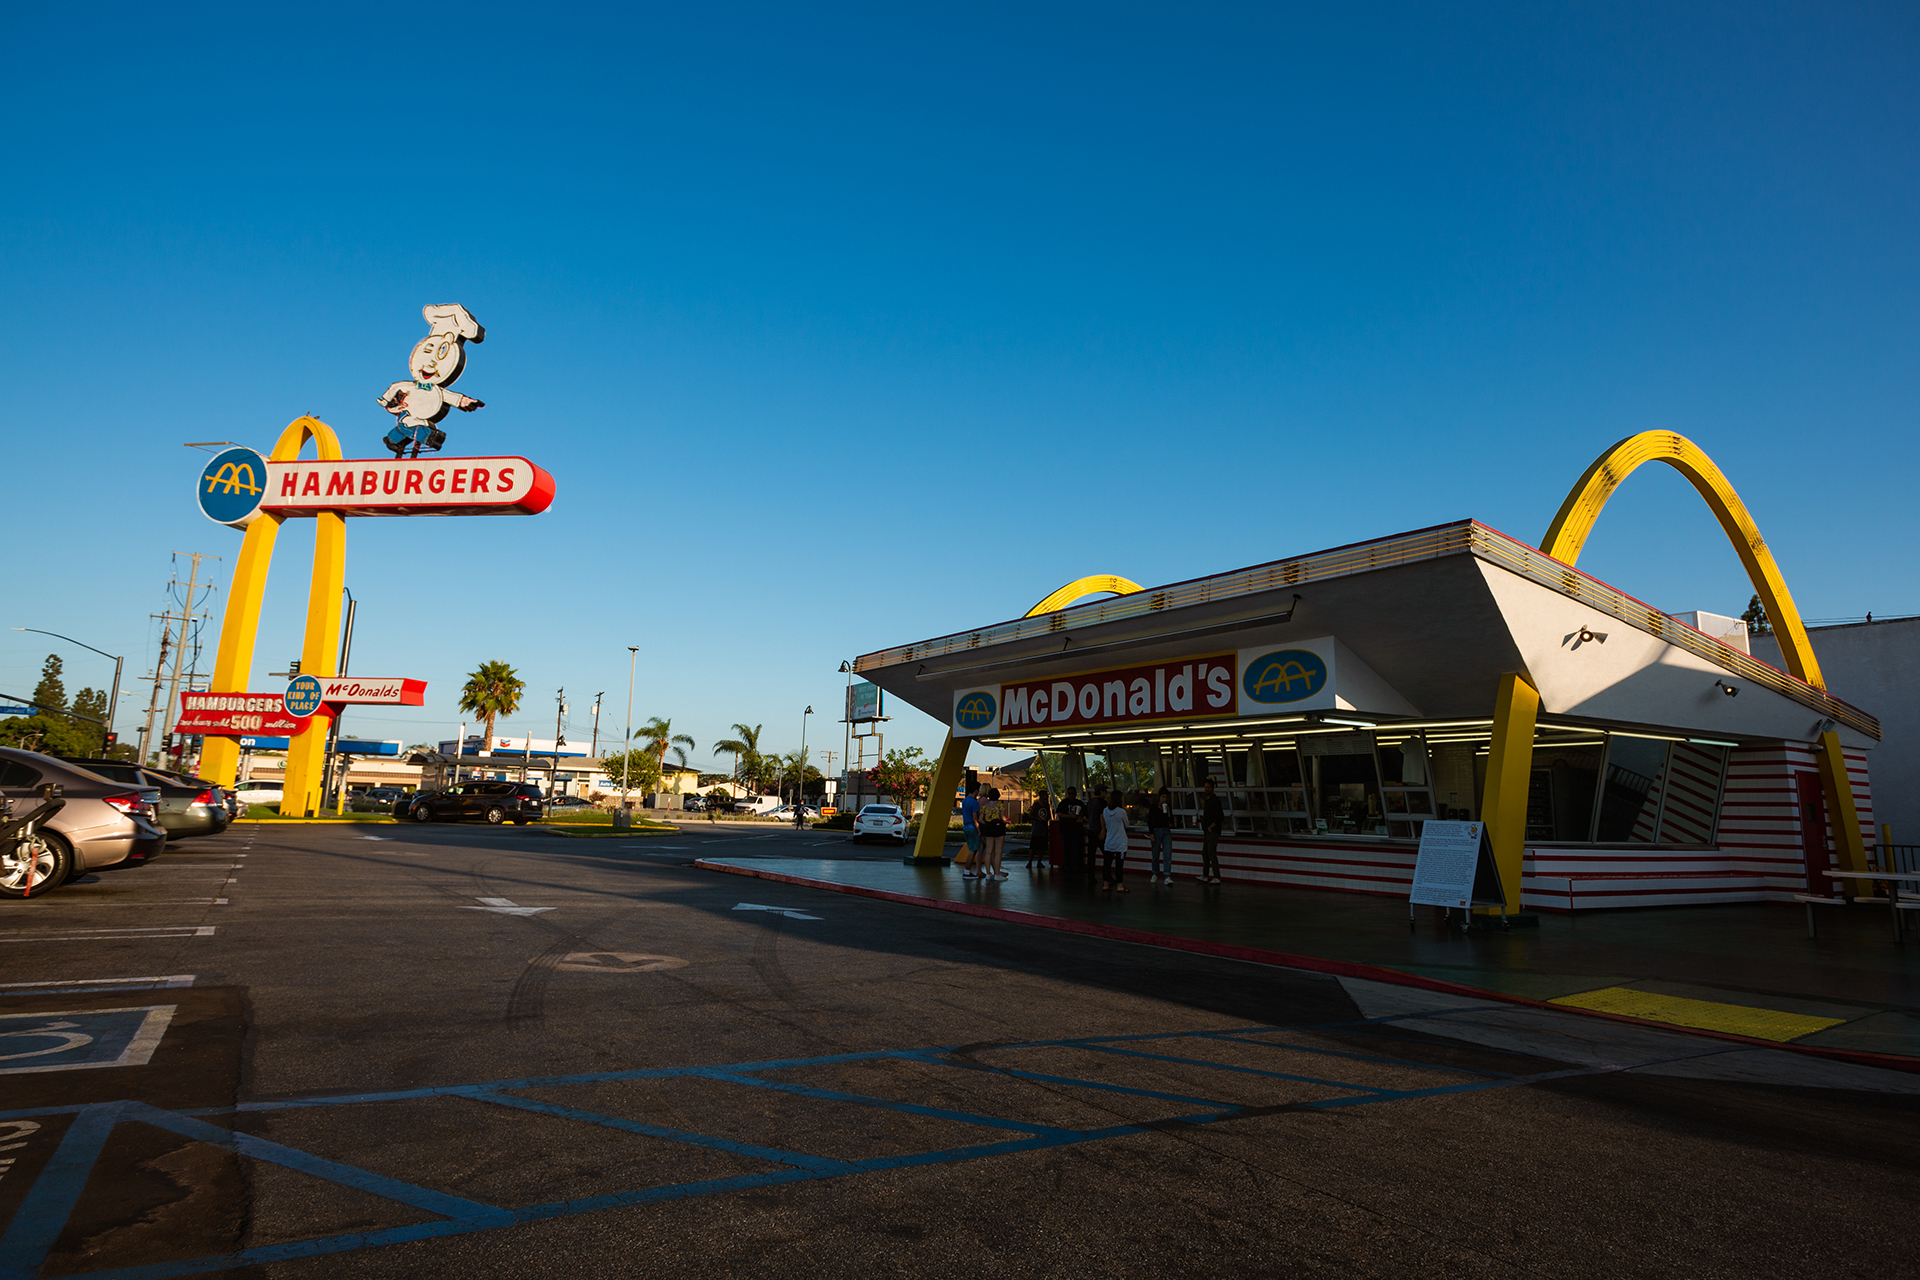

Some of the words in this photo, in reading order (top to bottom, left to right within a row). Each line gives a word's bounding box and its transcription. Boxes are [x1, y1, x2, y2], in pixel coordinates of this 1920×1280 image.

[280, 467, 515, 497] HAMBURGERS
[296, 681, 315, 691] YOUR
[325, 683, 400, 698] McDonalds
[287, 691, 305, 700] KIND
[309, 692, 320, 700] OF
[1001, 663, 1232, 726] McDonald's
[185, 696, 283, 713] HAMBURGERS
[290, 701, 315, 711] PLACE
[230, 715, 263, 731] 500
[264, 719, 297, 729] million
